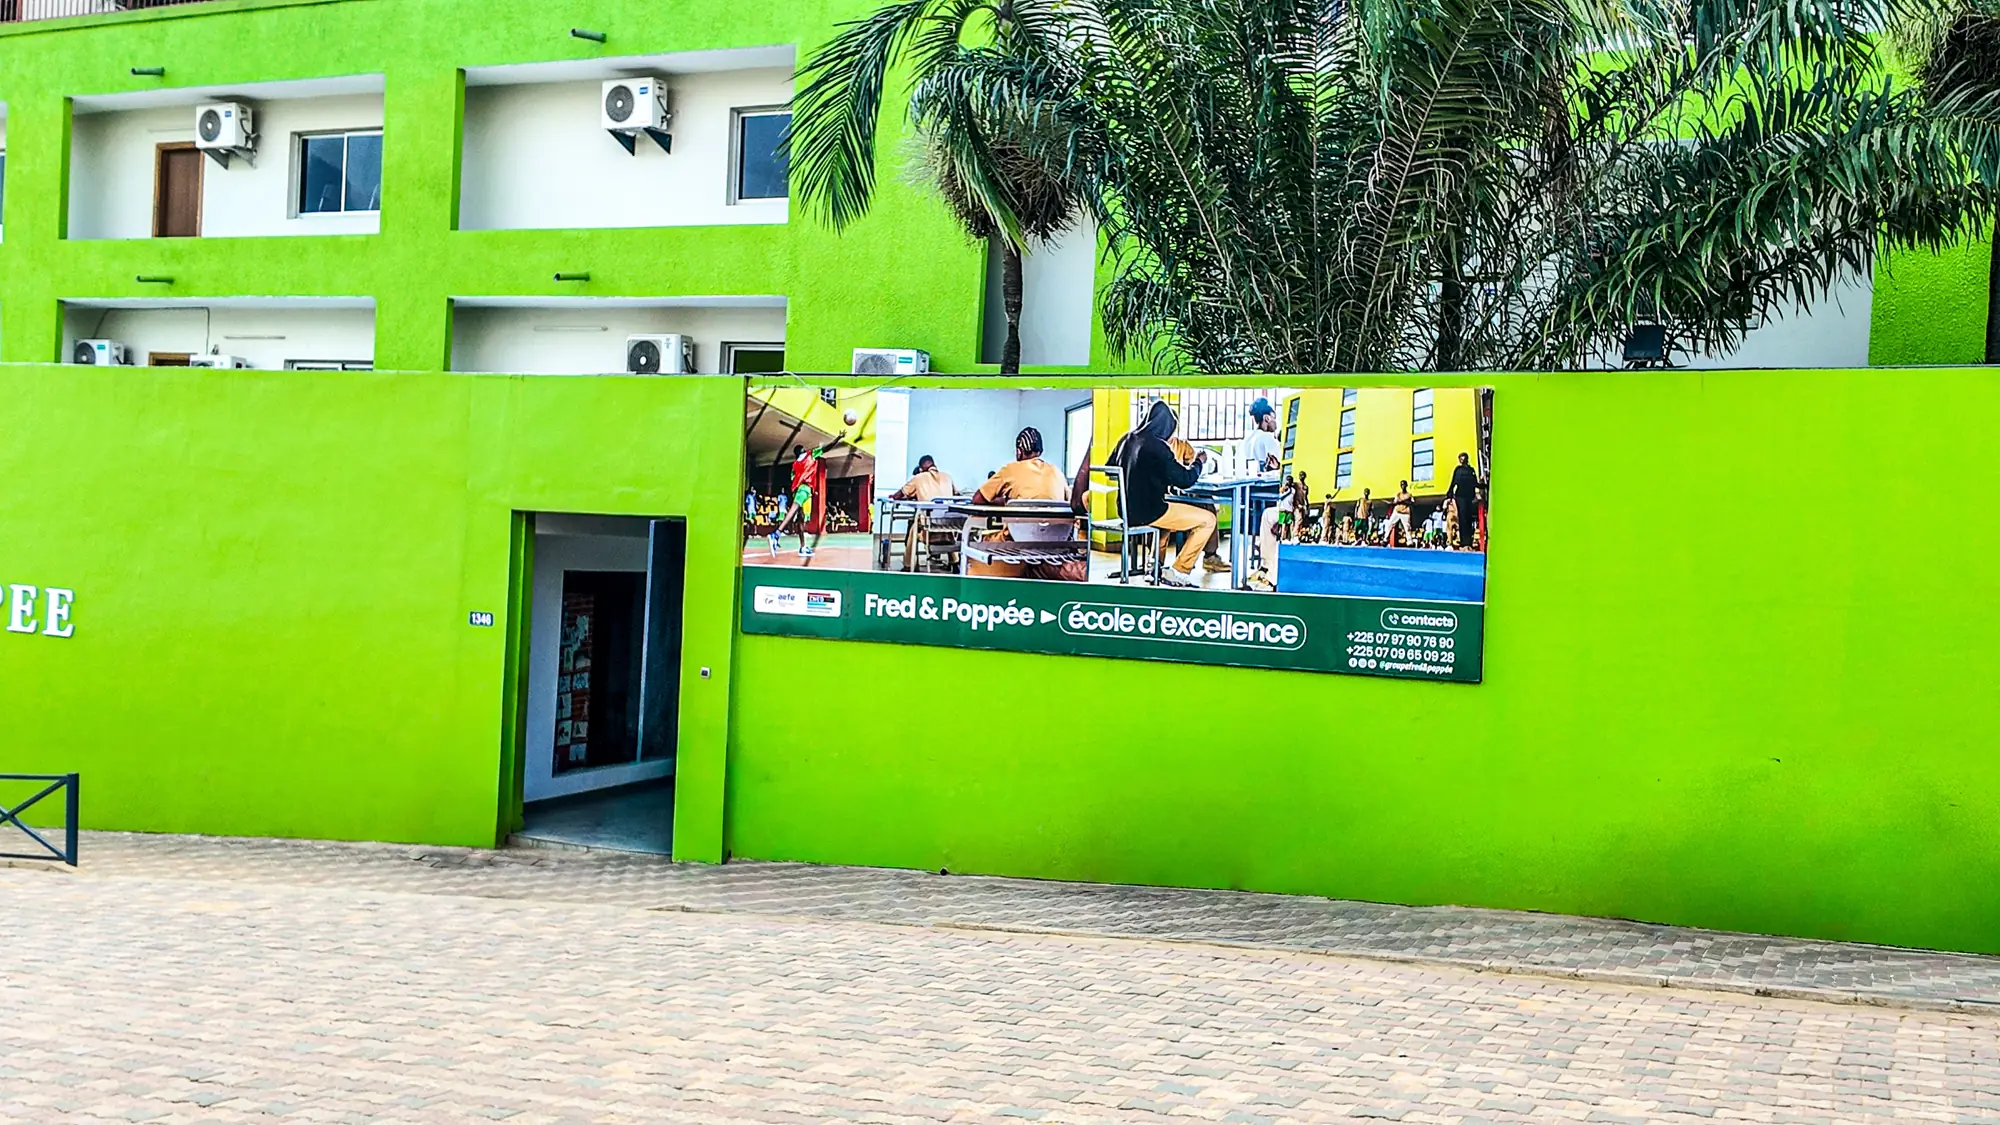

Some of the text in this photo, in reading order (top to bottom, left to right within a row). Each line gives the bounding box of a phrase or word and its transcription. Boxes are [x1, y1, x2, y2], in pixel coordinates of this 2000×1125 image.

[0, 583, 75, 638] EE
[864, 593, 1035, 631] Fred & Poppée
[1067, 603, 1300, 644] école d'excellence
[1401, 614, 1454, 628] contacts
[1346, 631, 1454, 649] +225 07 97 90 76 90
[1346, 645, 1455, 663] +225 07 09 65 09 28
